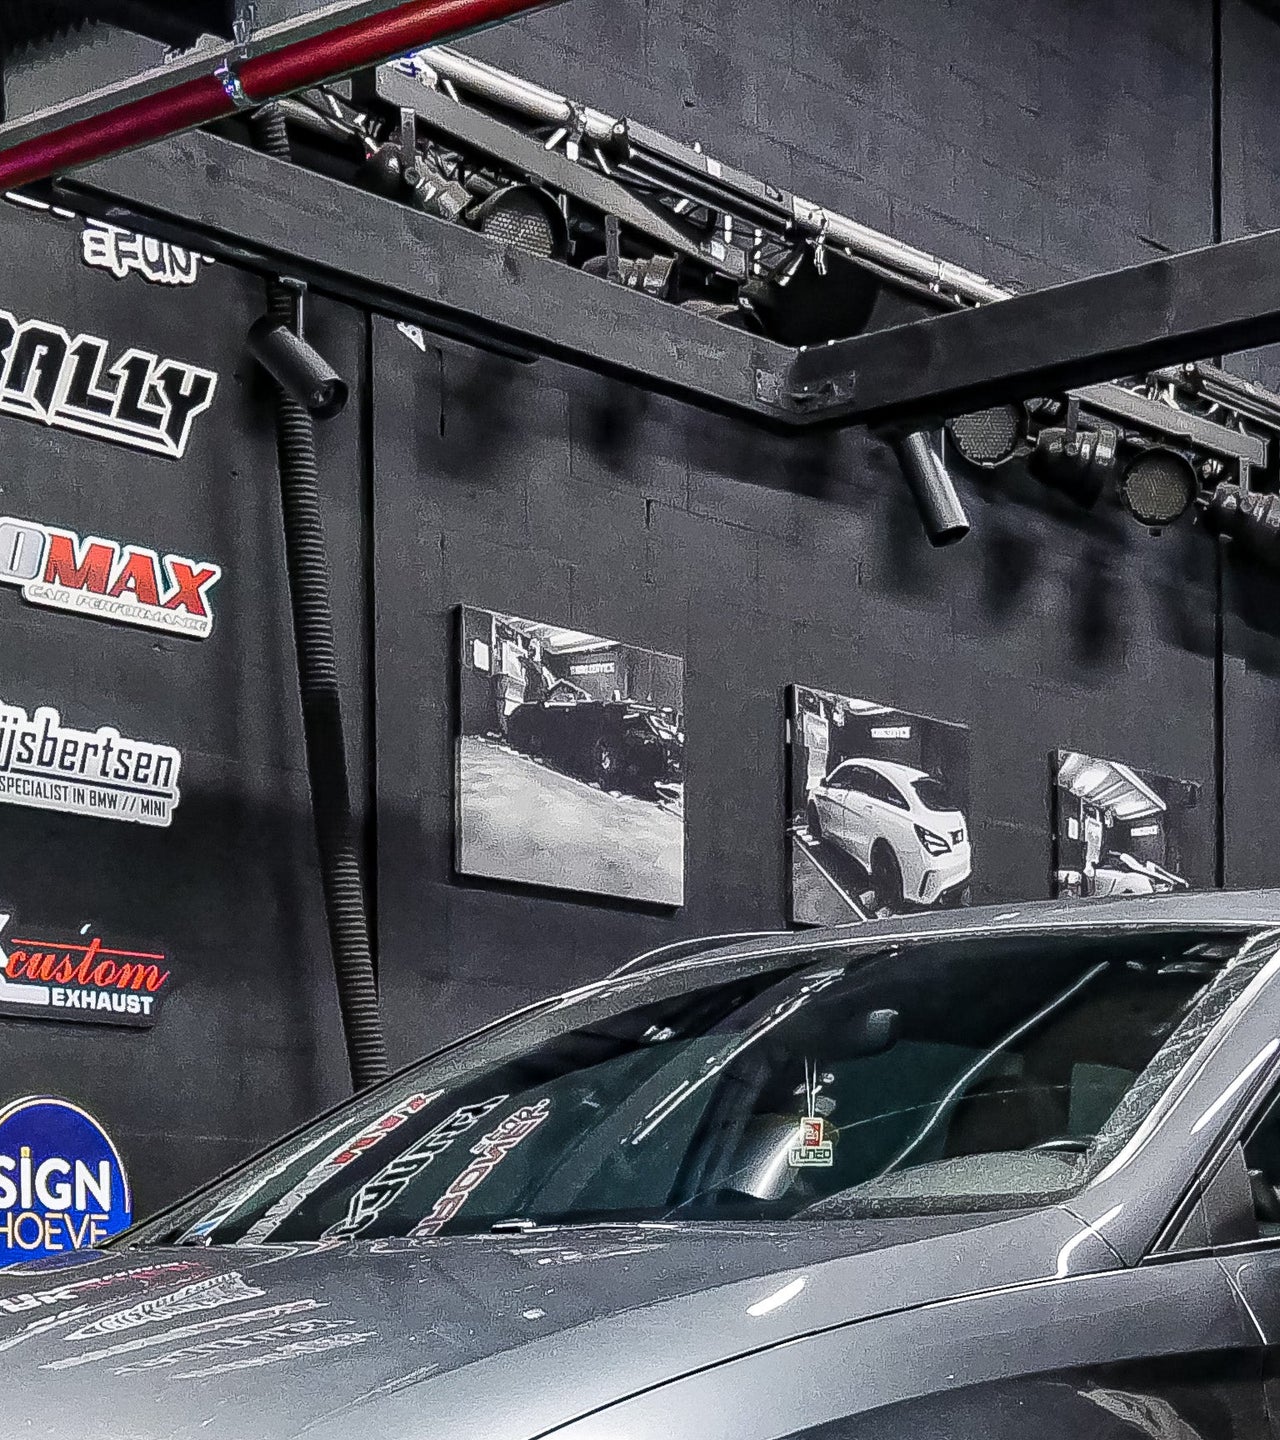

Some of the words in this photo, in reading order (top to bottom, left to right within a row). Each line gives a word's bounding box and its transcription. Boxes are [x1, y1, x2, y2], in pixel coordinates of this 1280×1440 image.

[28, 584, 70, 605] CAR
[76, 594, 208, 632] PERFORMANCE
[73, 787, 86, 805] IN
[89, 790, 119, 811] BMW
[140, 798, 166, 818] MINI
[5, 937, 171, 992] custom
[52, 990, 154, 1015] EXHAUST
